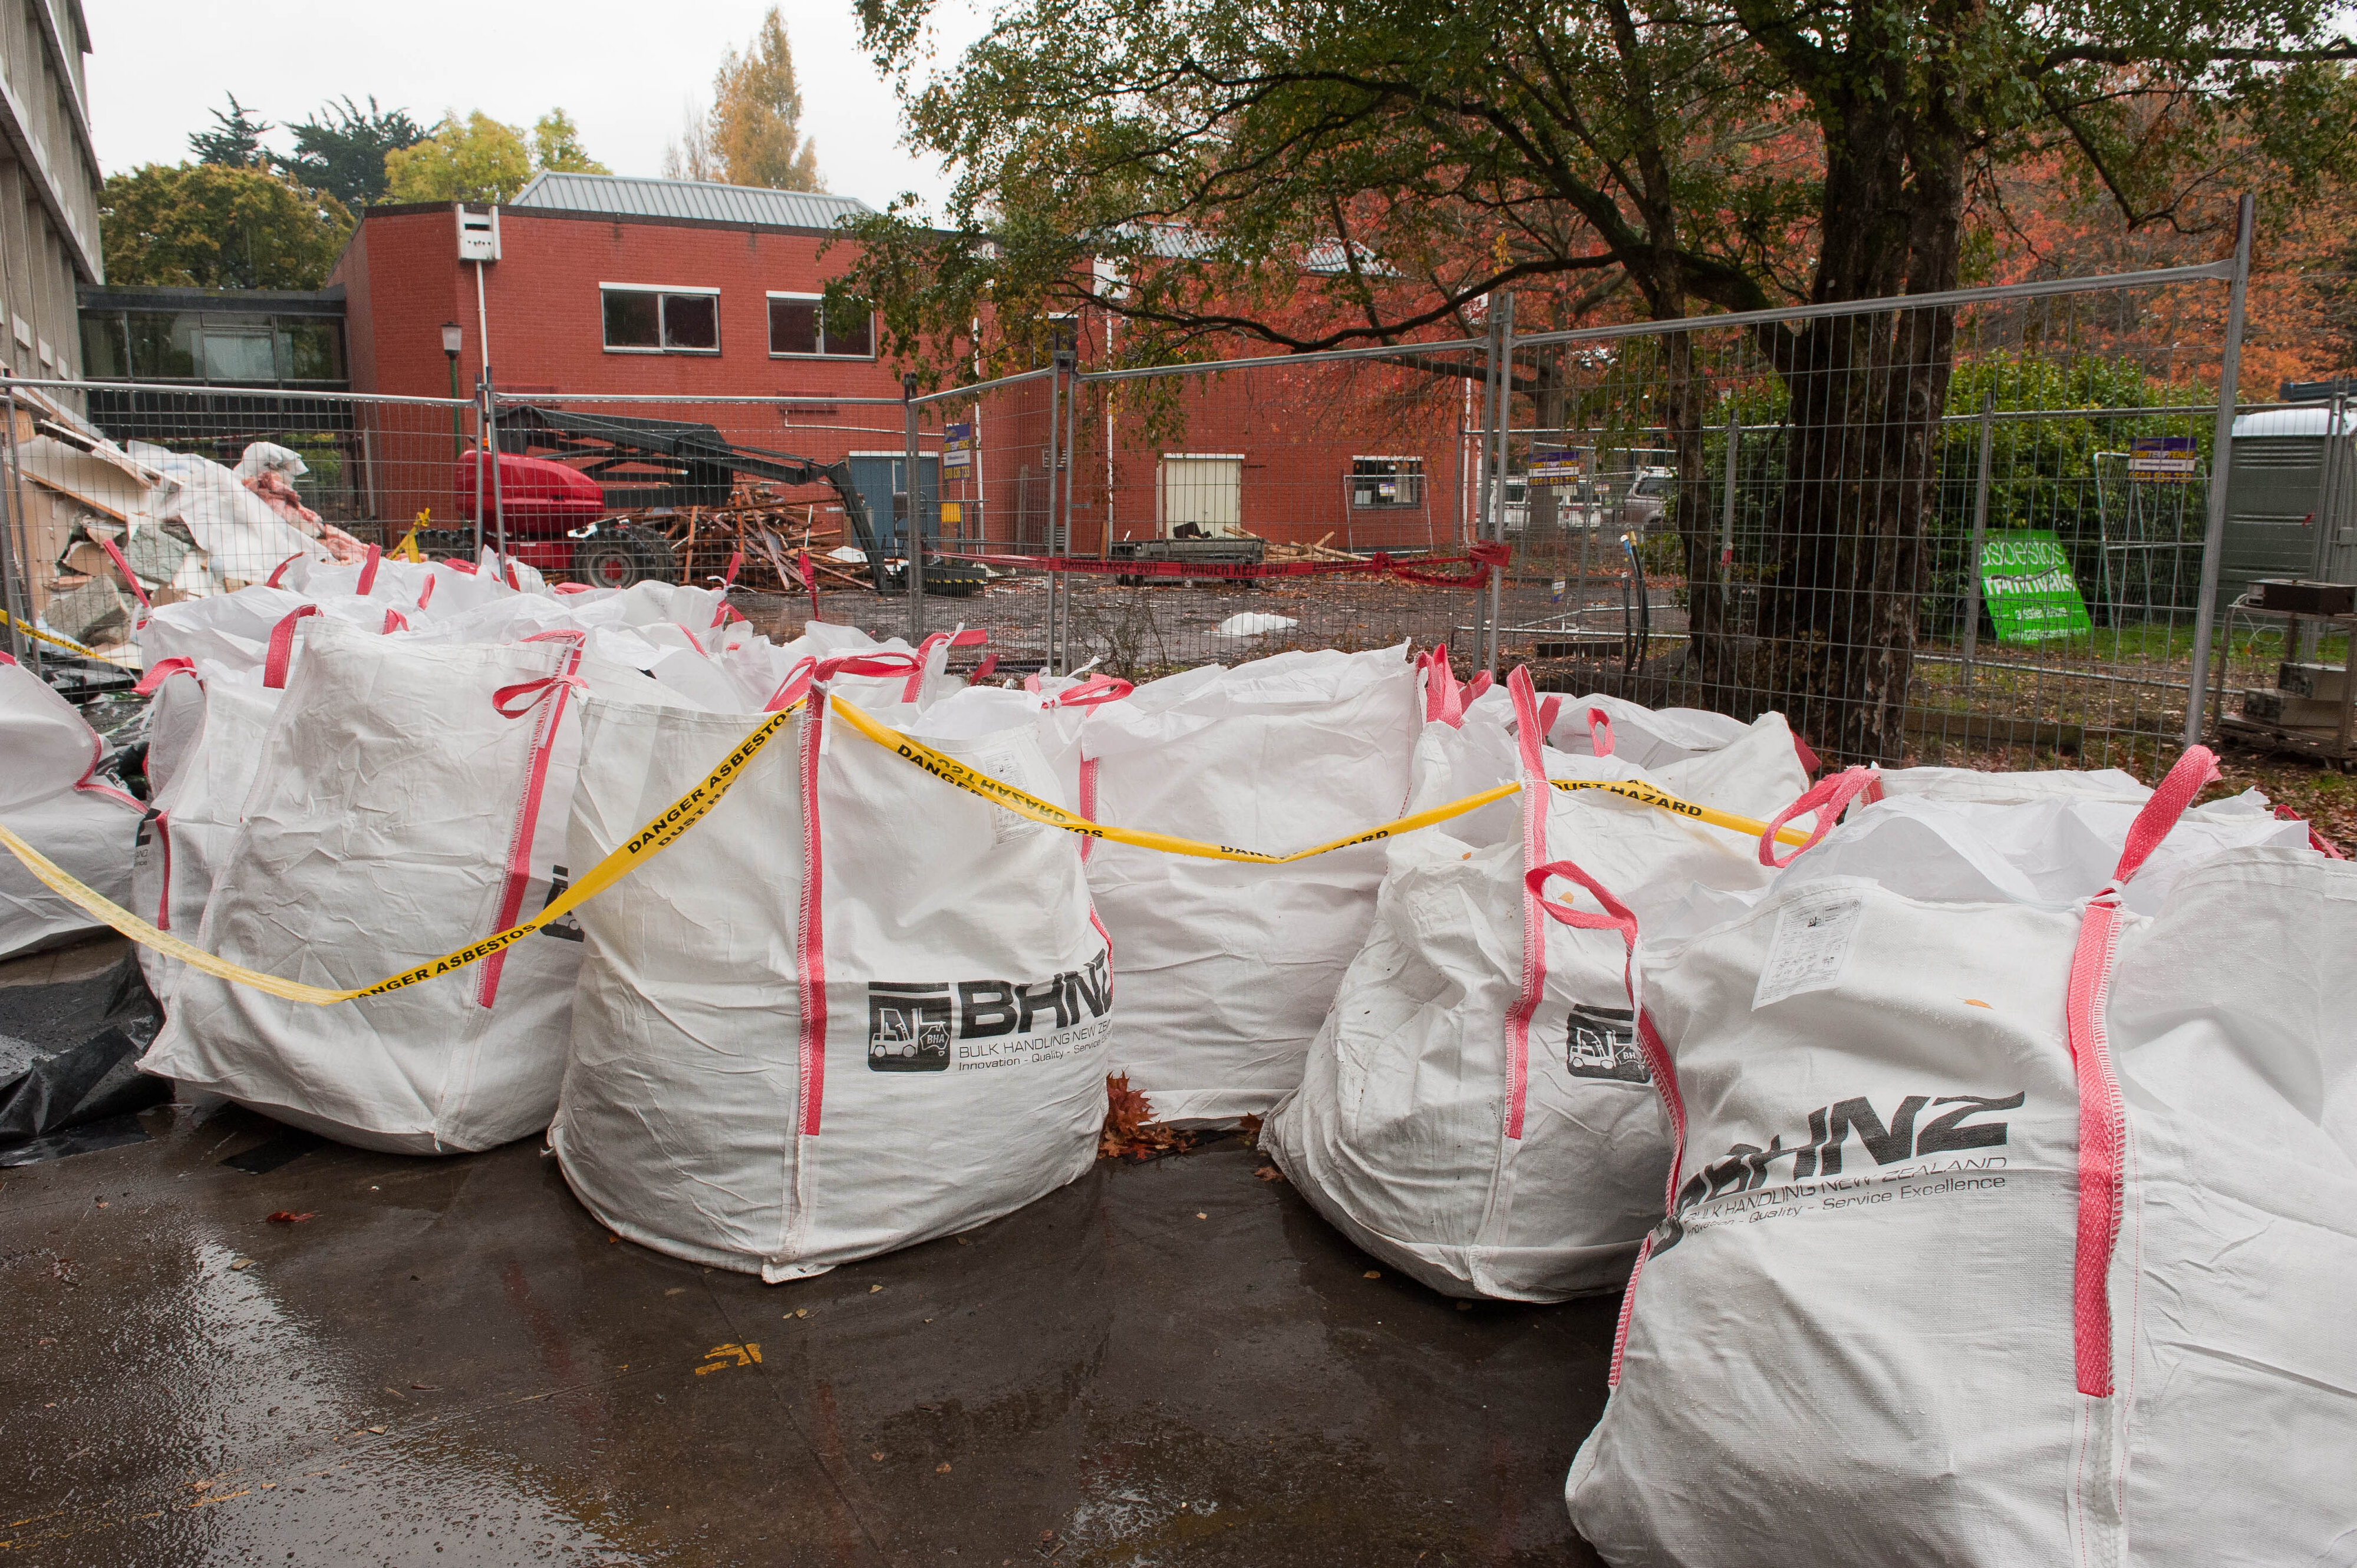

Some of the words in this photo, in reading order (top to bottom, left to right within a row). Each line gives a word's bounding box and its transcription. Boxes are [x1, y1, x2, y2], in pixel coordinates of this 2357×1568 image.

[1980, 538, 2065, 566] asbestos
[1610, 785, 1702, 816] HAZARD
[627, 788, 706, 854] DANGER
[658, 806, 704, 846] DUST
[341, 968, 430, 1001] ANGER
[436, 923, 537, 974] ASBESTOS
[927, 1034, 945, 1045] BHA
[959, 1058, 1020, 1071] Innovation
[1031, 1049, 1065, 1063] Quality
[1074, 1039, 1101, 1054] Service
[960, 1042, 1000, 1059] BULK
[1004, 1032, 1070, 1054] HANDLING
[1073, 1025, 1097, 1042] NEW
[1623, 1052, 1637, 1060] BH
[1725, 1184, 1815, 1215] HANDLING
[1822, 1174, 1877, 1193] NEW
[1882, 1157, 2007, 1182] ZEALAND
[1749, 1206, 1802, 1224] Quality
[1822, 1192, 1892, 1210] Service
[1900, 1178, 2006, 1199] Excellence
